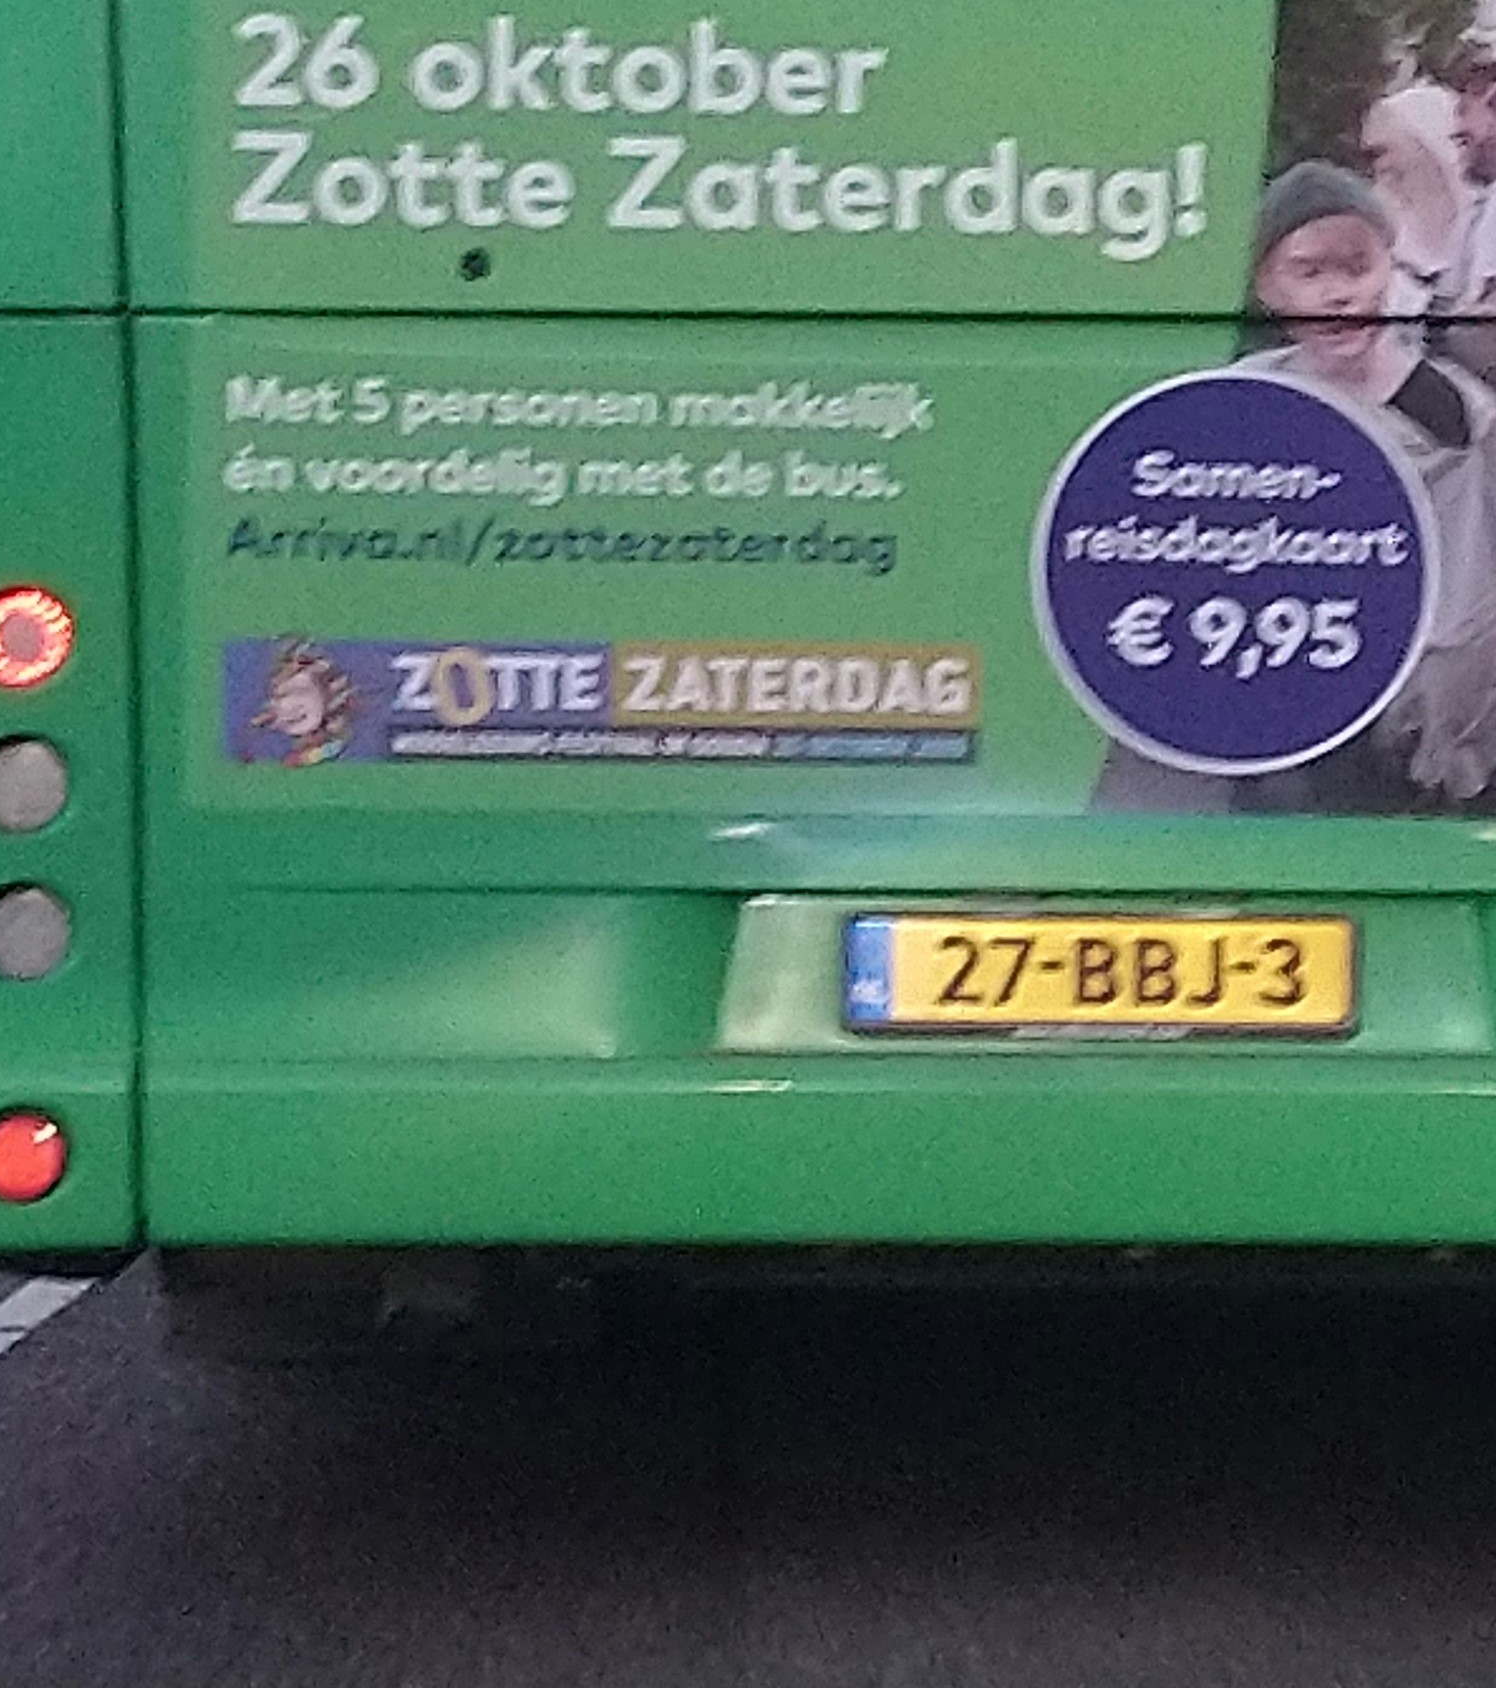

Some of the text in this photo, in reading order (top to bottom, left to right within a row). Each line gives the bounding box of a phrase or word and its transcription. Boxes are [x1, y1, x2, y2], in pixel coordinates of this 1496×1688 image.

[230, 13, 889, 113] 26 oktober
[228, 128, 1209, 264] Zotte Zaterdag!
[225, 374, 935, 440] Met 5 personen makkelijk
[222, 442, 905, 509] én voordelig met de bus.
[1131, 449, 1342, 500] Samen-
[226, 515, 899, 577] Arriva.nl/zottezaterdag
[1063, 514, 1409, 574] reisdagkaart
[1106, 595, 1363, 679] € 9,95
[389, 646, 973, 728] ZOTTE ZATERDAG
[935, 934, 1307, 1008] 27-BBJ-3
